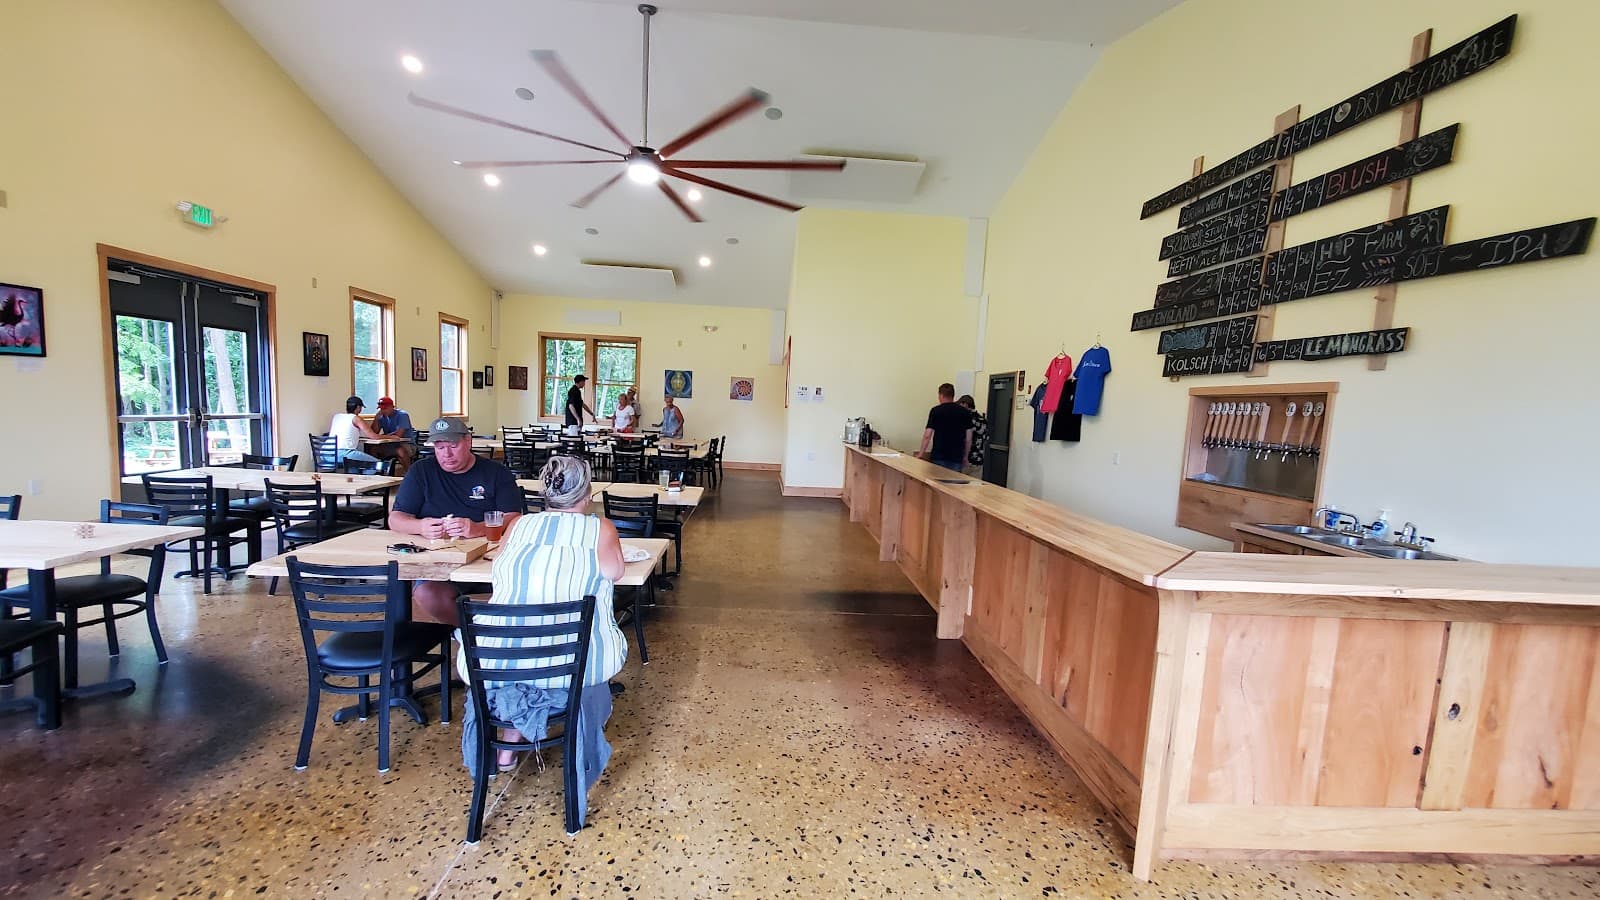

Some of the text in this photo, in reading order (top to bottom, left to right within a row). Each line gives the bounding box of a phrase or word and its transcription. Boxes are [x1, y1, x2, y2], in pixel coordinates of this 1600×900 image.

[1355, 88, 1385, 120] DRY
[1390, 54, 1461, 106] NECTAR
[1465, 30, 1505, 74] ALE
[1262, 174, 1273, 192] 2
[1326, 156, 1390, 200] BLUSH
[192, 205, 213, 226] EXIT
[1259, 205, 1268, 224] 3
[1267, 261, 1277, 276] 13
[1363, 228, 1403, 255] FARM
[1252, 263, 1261, 282] 5
[1262, 289, 1273, 301] 14
[1403, 250, 1445, 279] SOFT
[1477, 233, 1548, 268] IPA
[1249, 293, 1259, 308] 6
[1246, 323, 1255, 339] 7
[1168, 355, 1209, 372] KOLSCH
[1243, 351, 1251, 368] 8
